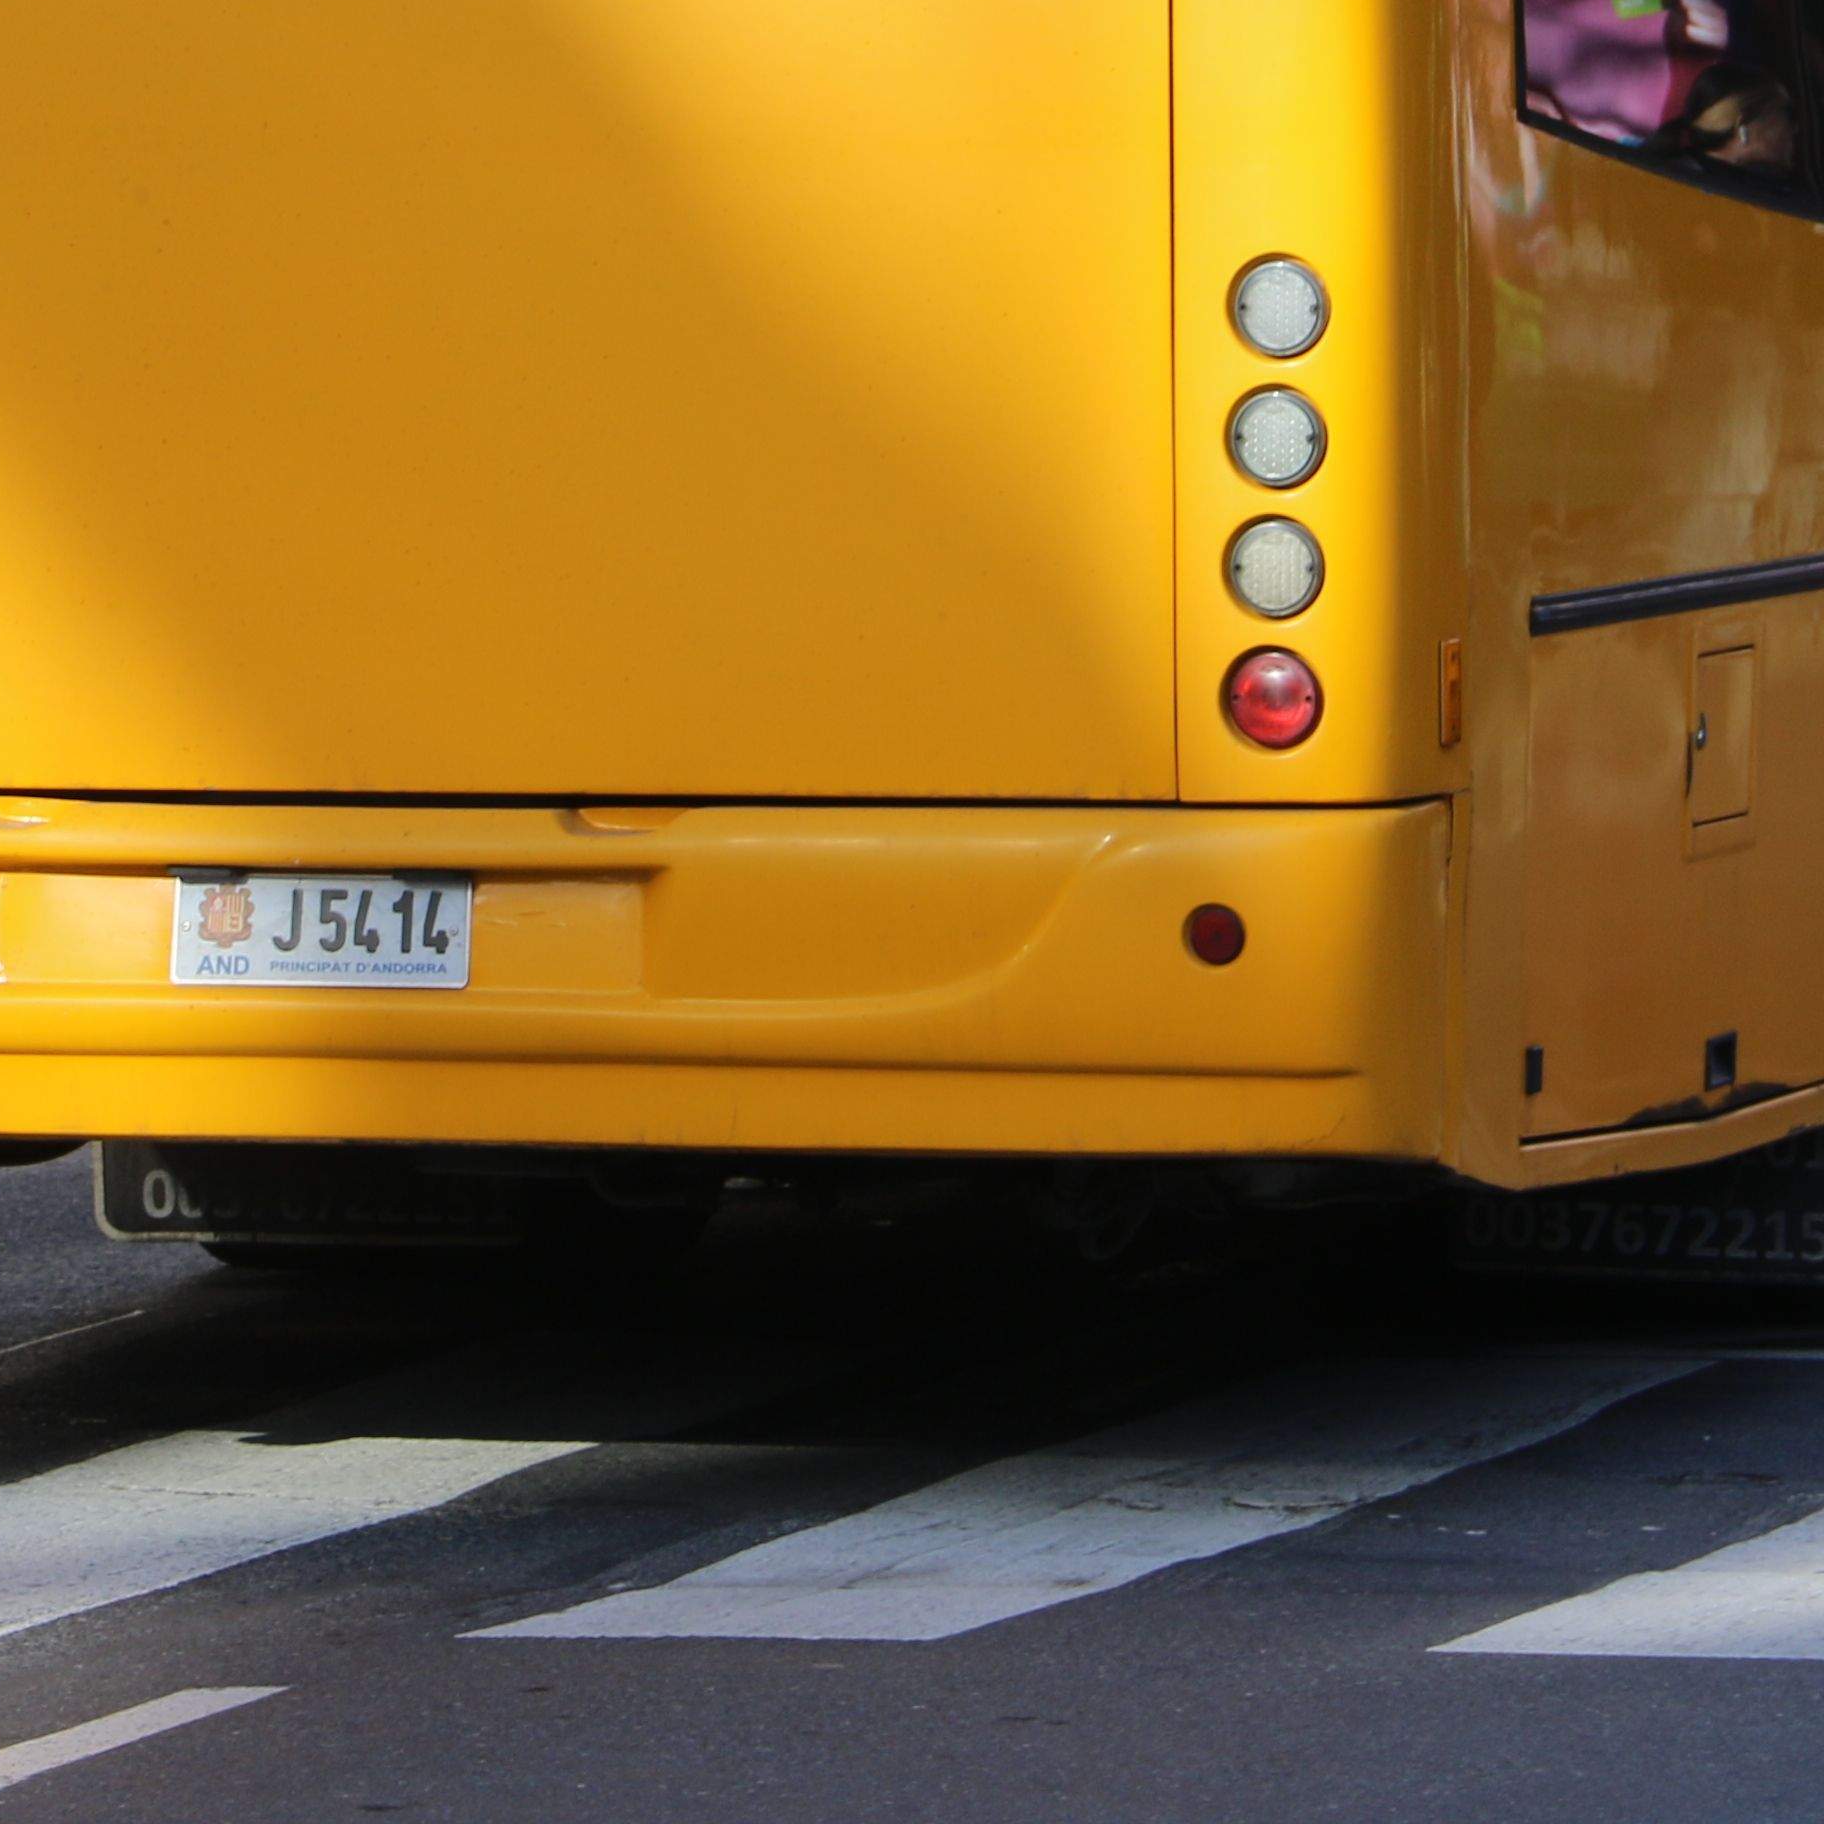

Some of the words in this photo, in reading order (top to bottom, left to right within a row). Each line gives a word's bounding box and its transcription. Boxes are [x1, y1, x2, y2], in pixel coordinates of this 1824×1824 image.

[272, 888, 449, 954] J5414
[197, 955, 250, 976] AND
[270, 960, 350, 973] PRINCIPAT
[356, 961, 448, 975] D'ANDORRA
